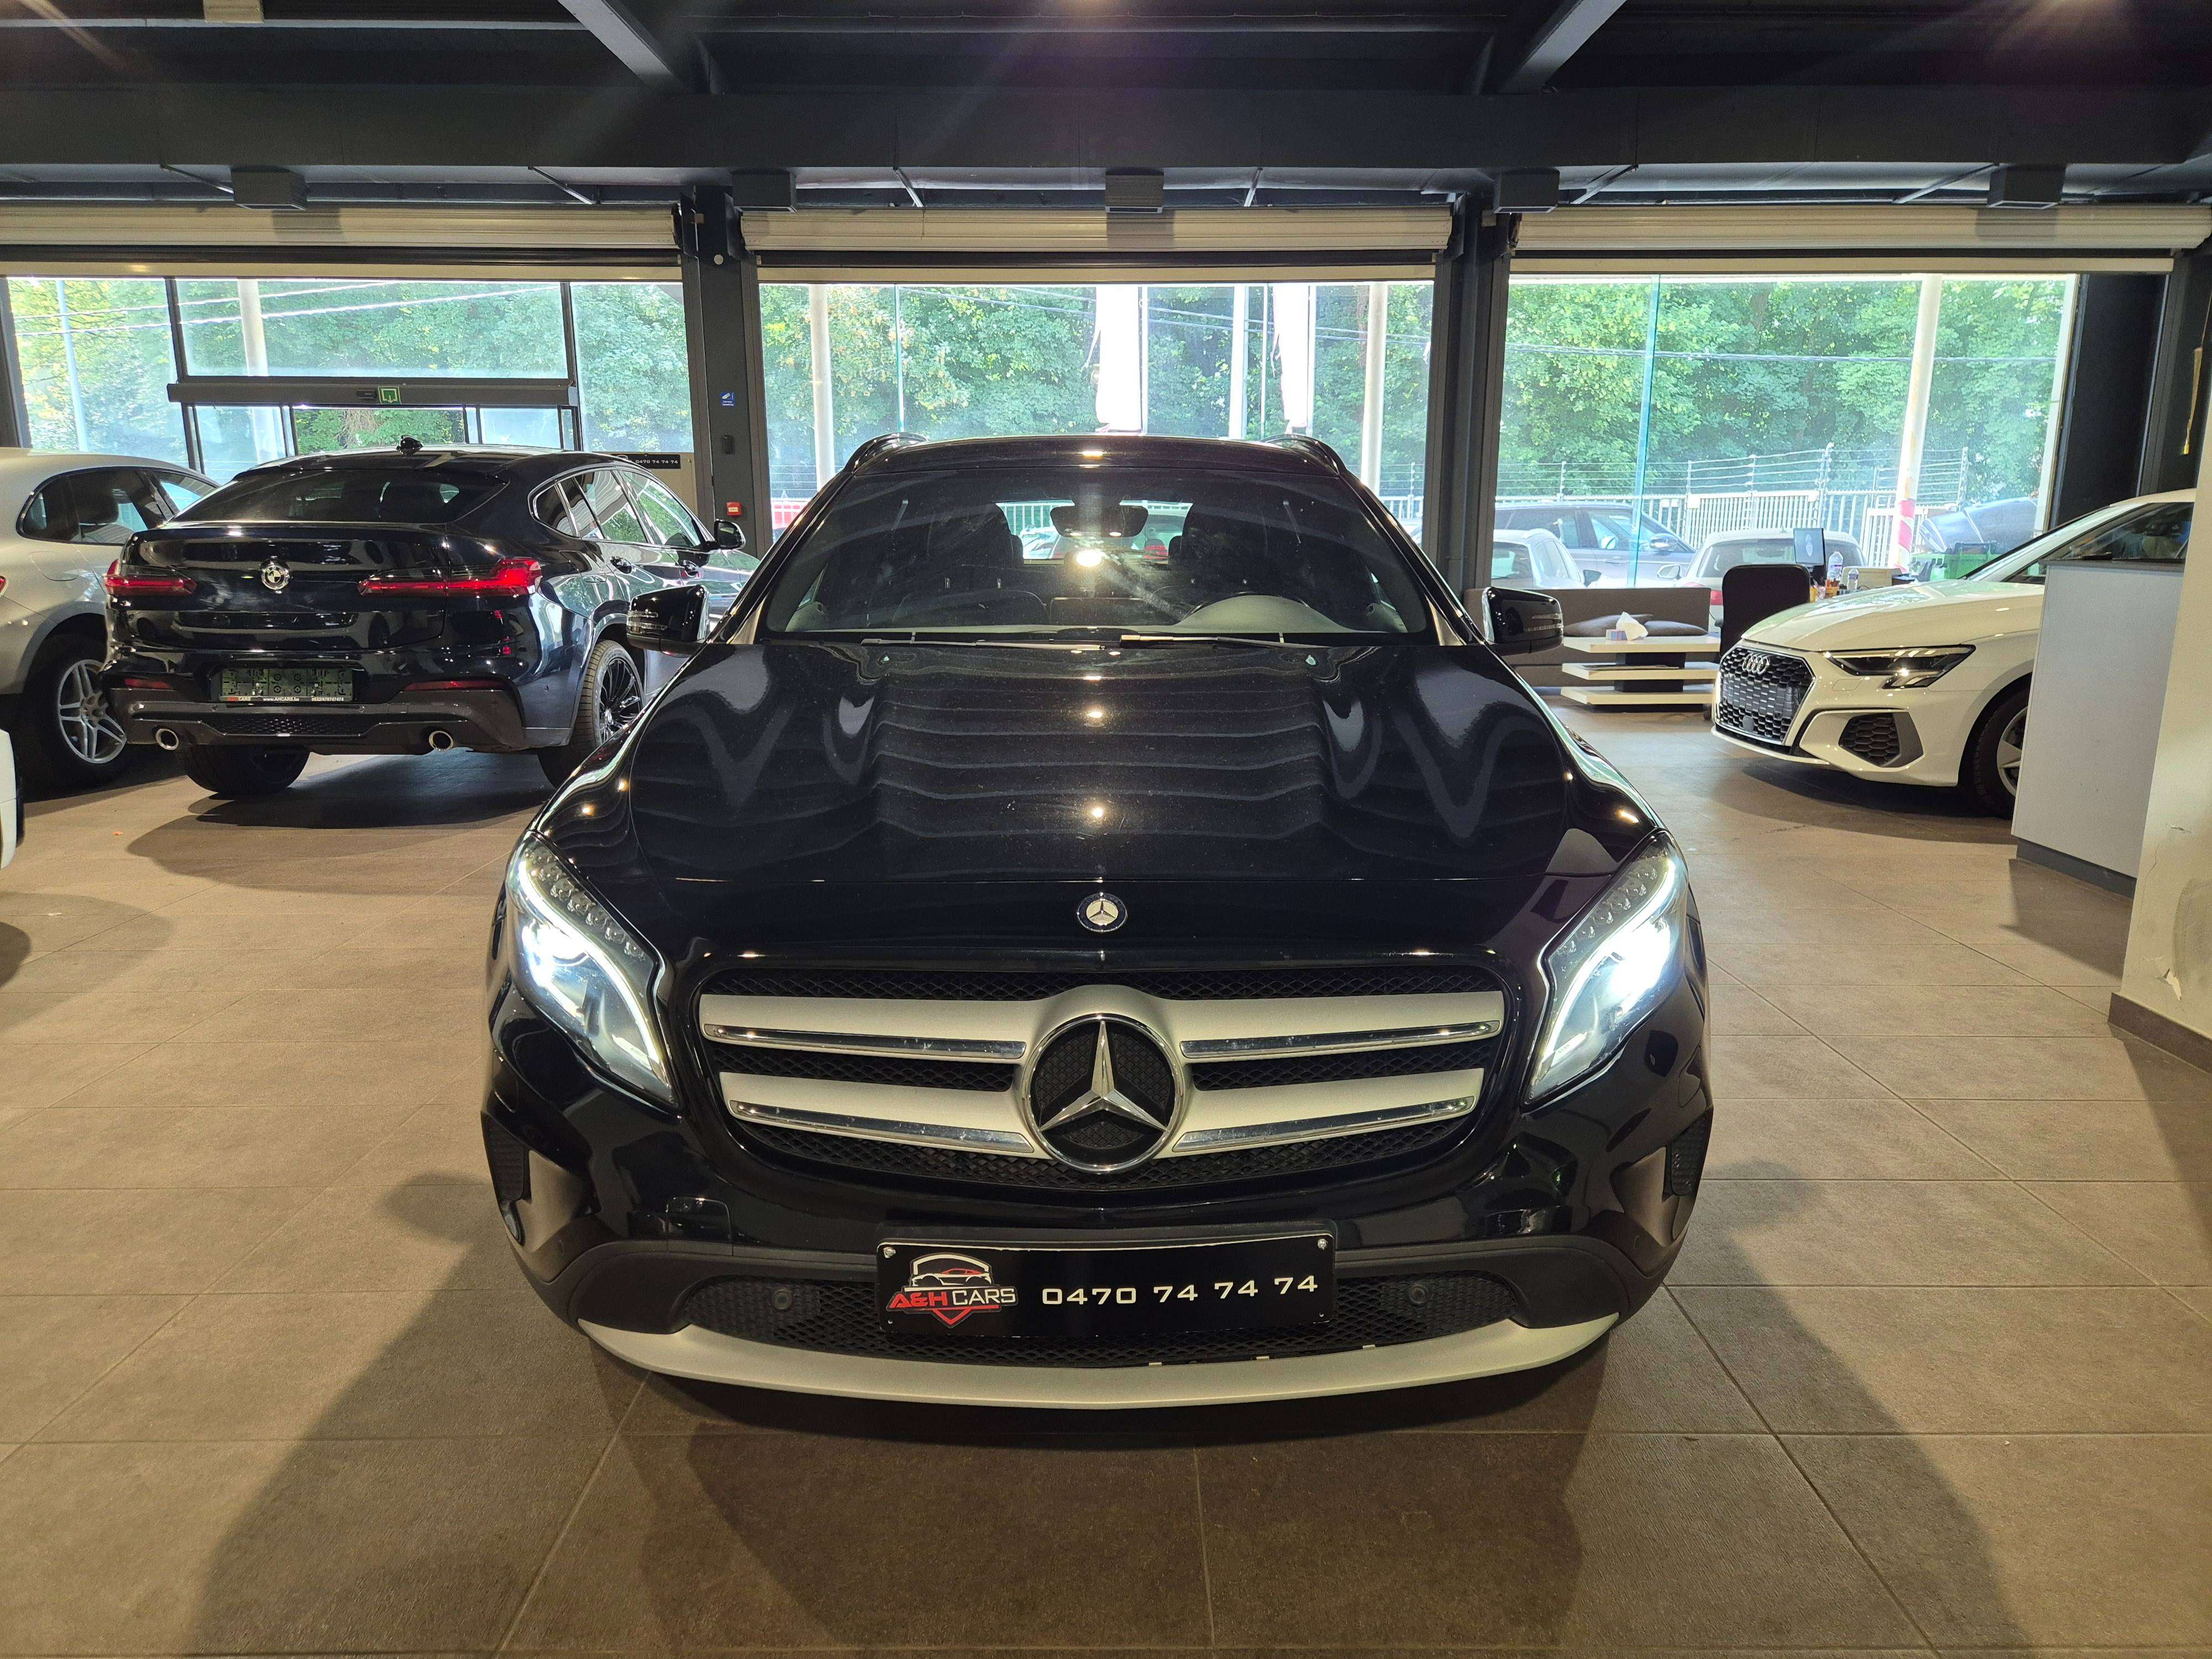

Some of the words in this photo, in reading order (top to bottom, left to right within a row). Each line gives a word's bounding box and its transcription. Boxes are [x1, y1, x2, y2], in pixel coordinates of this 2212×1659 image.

[889, 1292, 948, 1308] A&H
[952, 1288, 1016, 1306] CARS
[1042, 1287, 1136, 1305] 0470
[1154, 1285, 1198, 1302] 74
[1214, 1280, 1259, 1299] 74
[1274, 1275, 1318, 1295] 74
